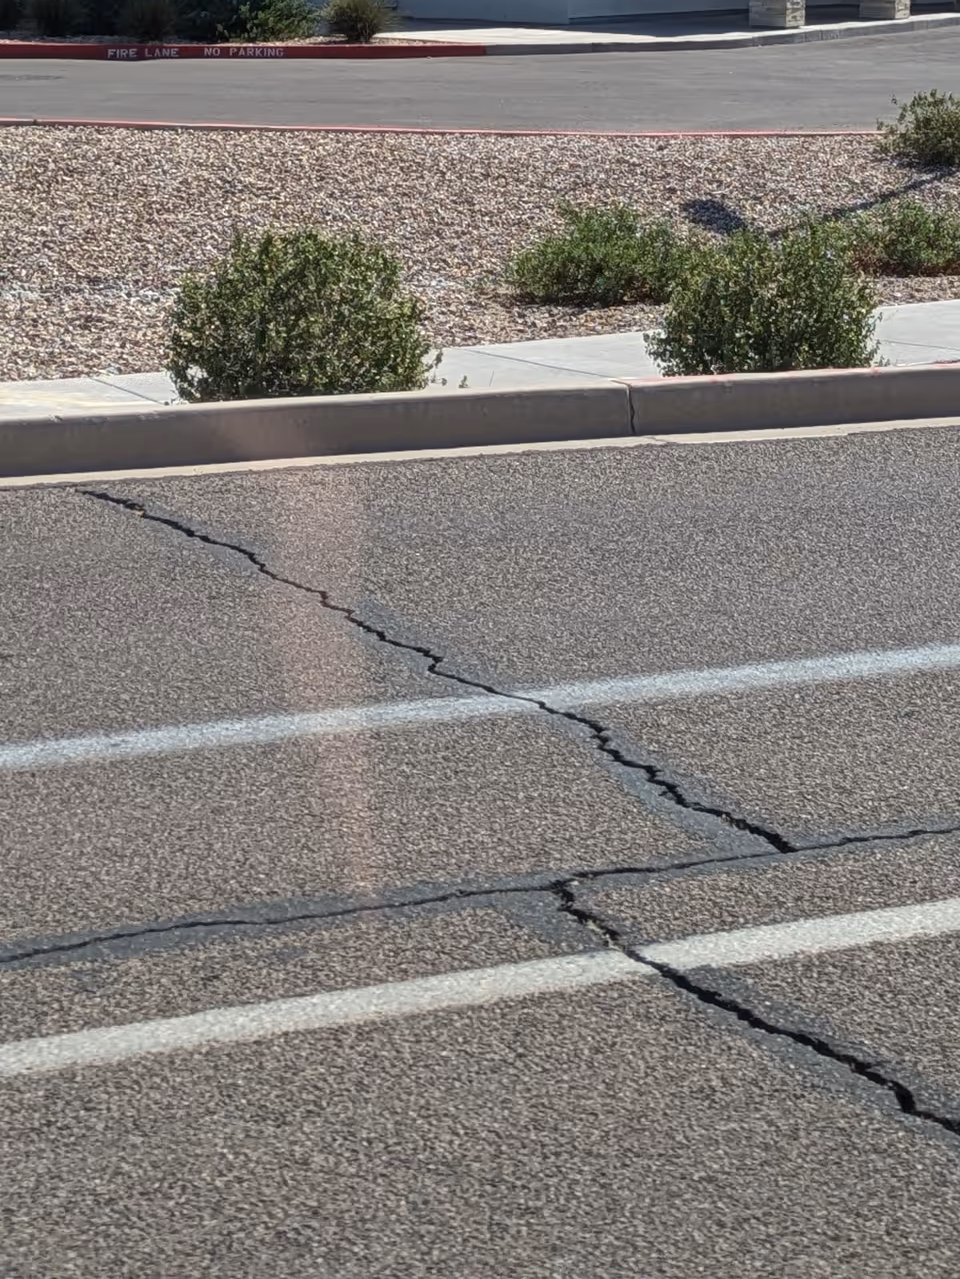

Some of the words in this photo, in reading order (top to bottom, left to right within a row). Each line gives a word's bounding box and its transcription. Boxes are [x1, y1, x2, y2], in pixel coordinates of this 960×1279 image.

[107, 48, 138, 59] FIRE
[144, 47, 180, 58] LANE
[203, 46, 221, 57] NO
[229, 47, 284, 58] PARKING
